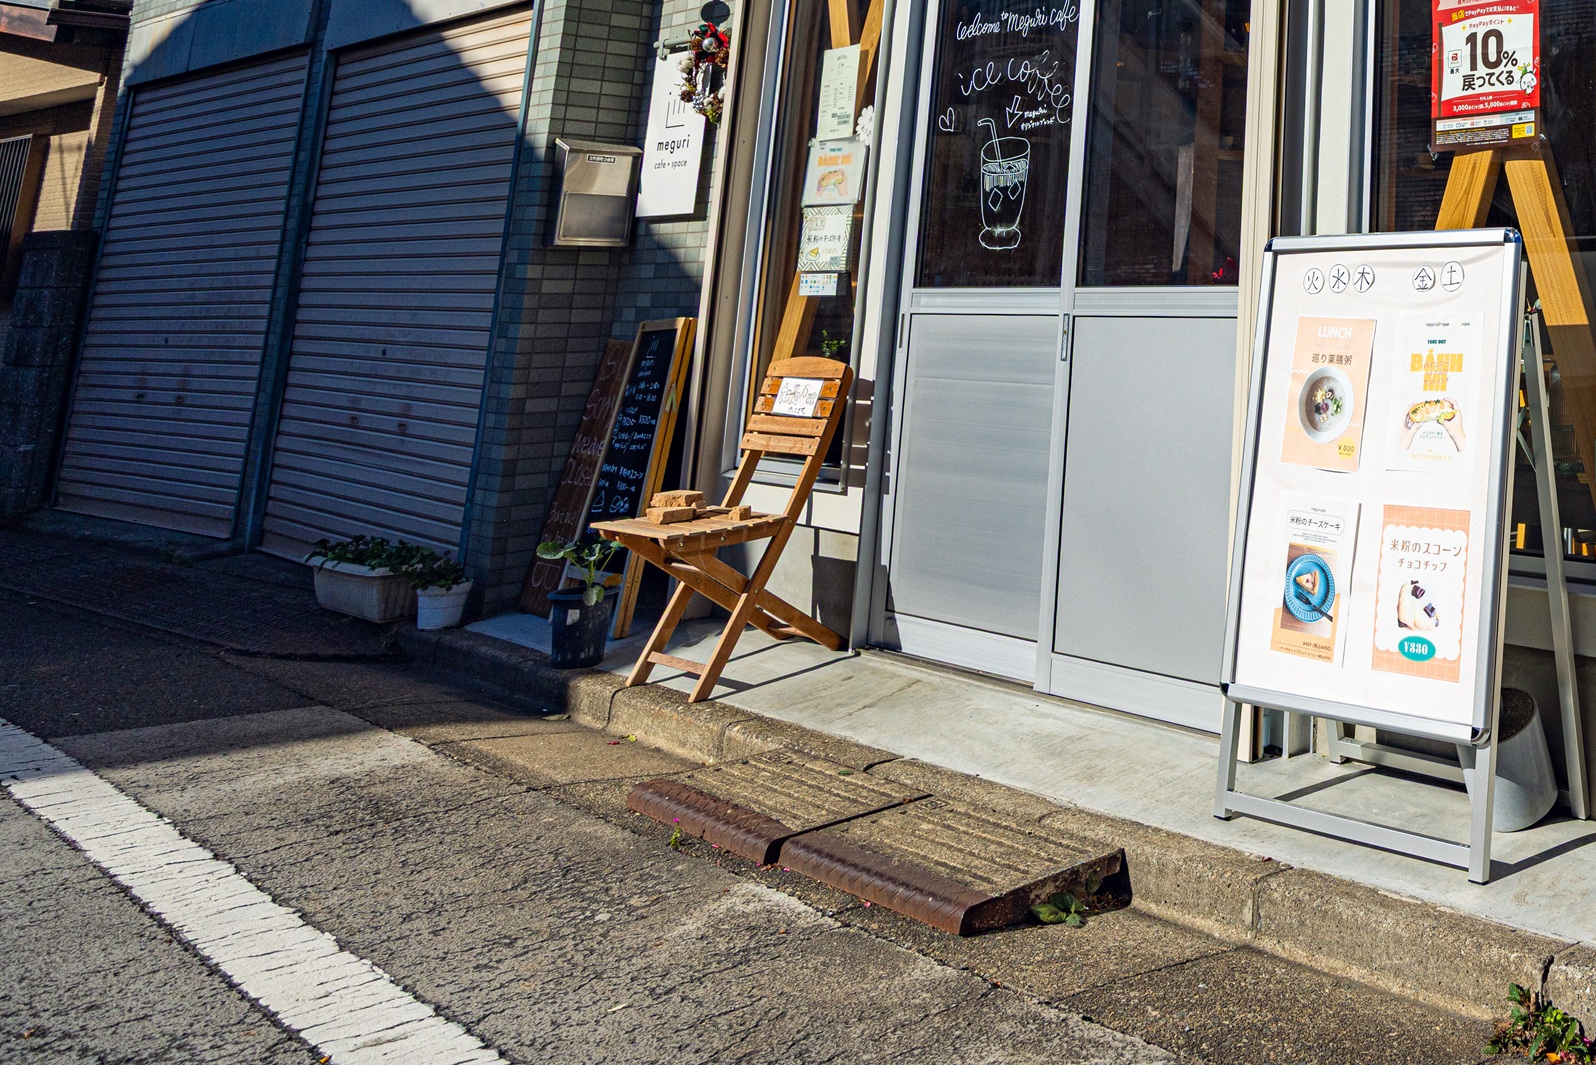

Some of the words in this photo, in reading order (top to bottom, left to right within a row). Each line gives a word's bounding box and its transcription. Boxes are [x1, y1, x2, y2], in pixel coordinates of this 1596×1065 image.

[1001, 11, 1008, 20] to
[1469, 19, 1504, 29] PayPayポイント
[1465, 28, 1518, 72] 10%
[959, 62, 1001, 95] ice
[1462, 70, 1514, 91] 戻ってくる
[657, 134, 690, 154] meguri
[654, 159, 666, 169] cafe
[671, 159, 687, 170] space
[1414, 268, 1432, 290] 金
[1317, 326, 1352, 339] LUNCH
[1312, 353, 1352, 365] 巡り薬膳粥
[1338, 444, 1354, 452] ¥800
[1290, 516, 1340, 530] 米粉のチーズケーキ
[1390, 539, 1462, 556] 米粉のスコーン
[1398, 558, 1447, 571] チョコチップ
[1404, 641, 1428, 655] ¥330
